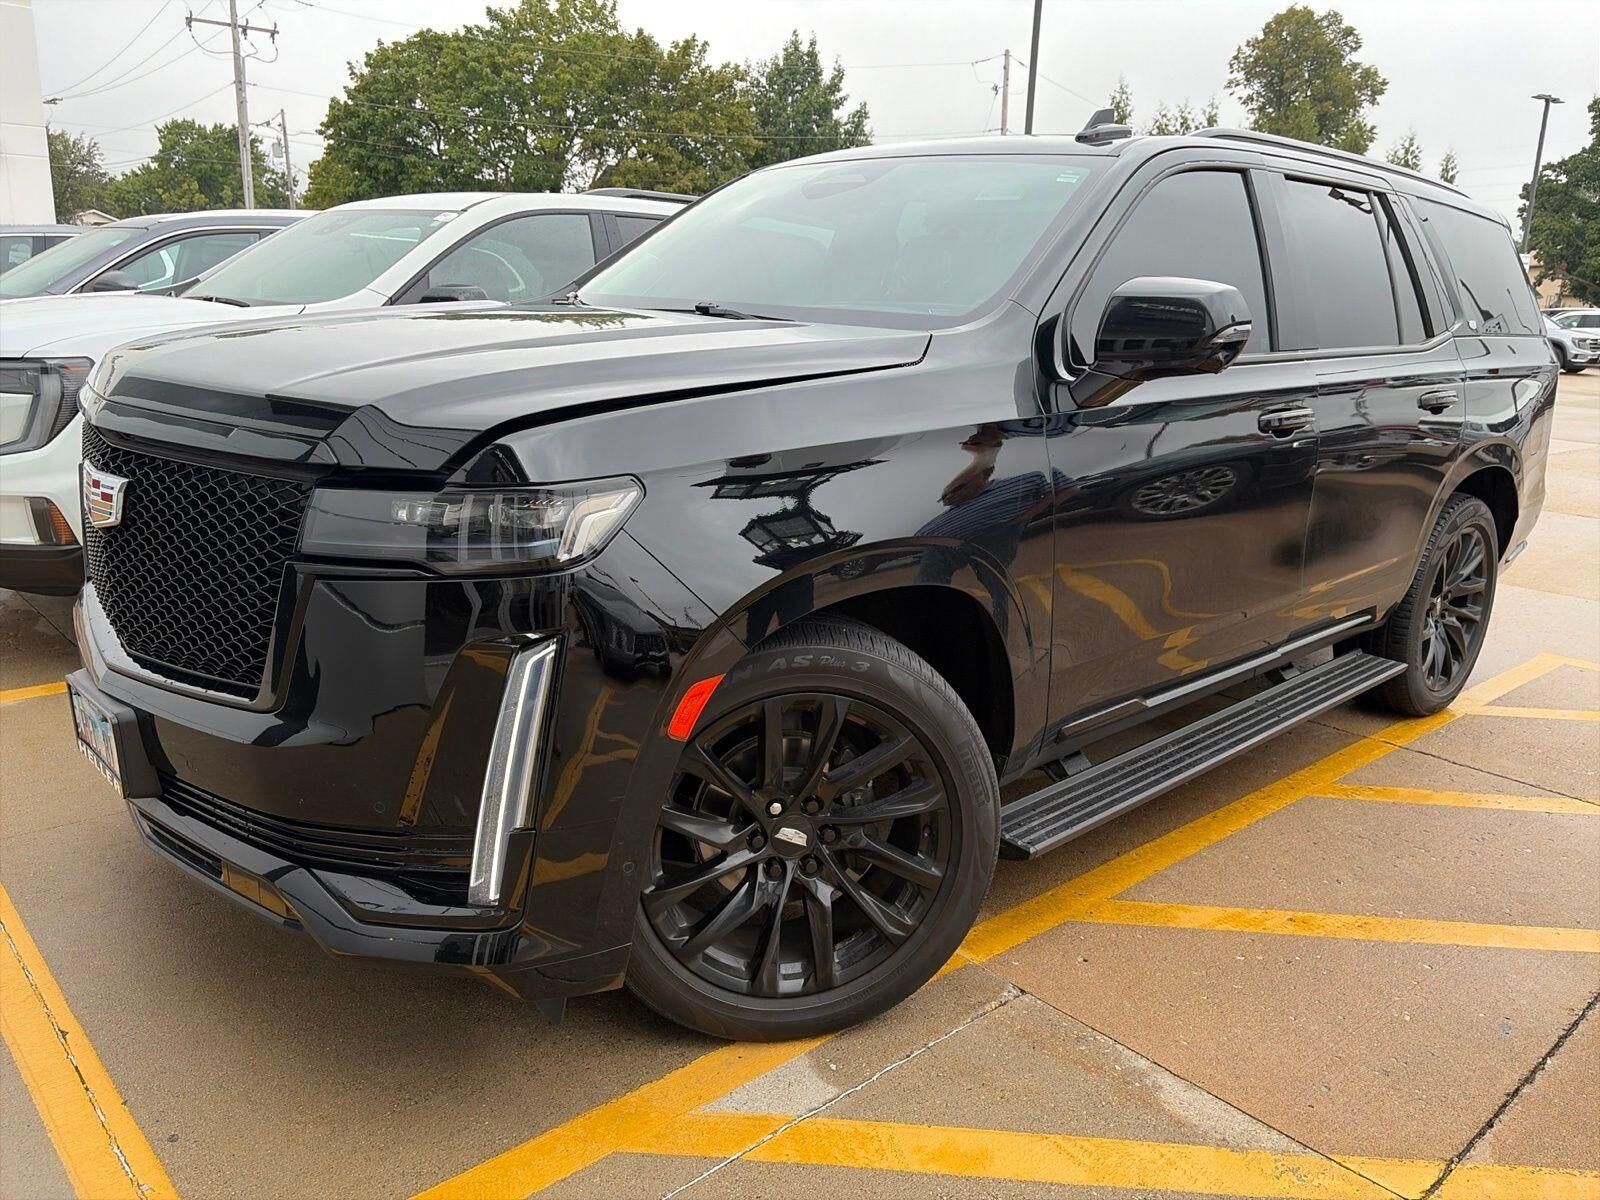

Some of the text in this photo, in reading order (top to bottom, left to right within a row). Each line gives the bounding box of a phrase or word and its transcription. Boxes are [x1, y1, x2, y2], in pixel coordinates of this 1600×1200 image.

[767, 655, 871, 672] AS Plus 3
